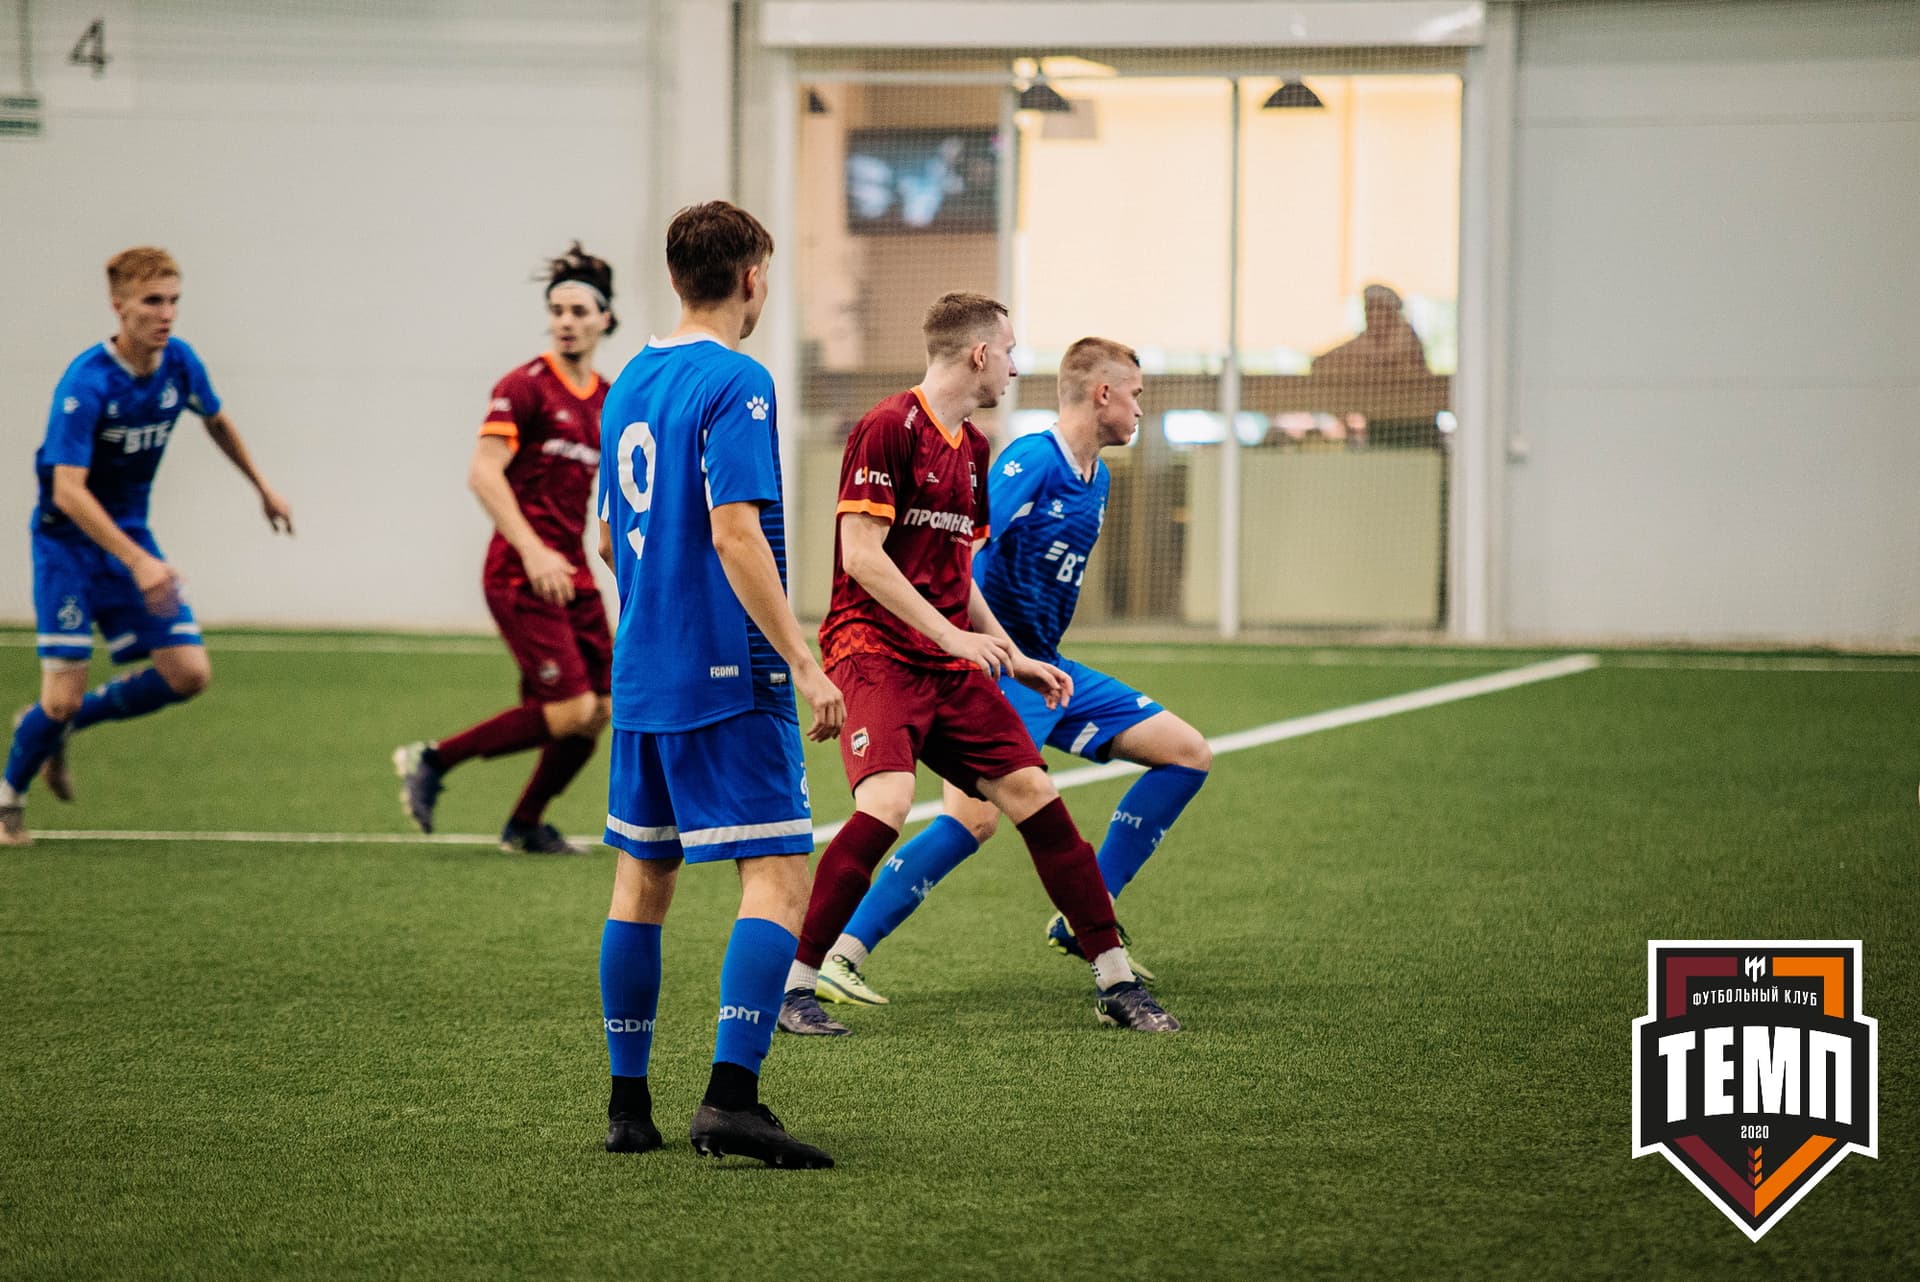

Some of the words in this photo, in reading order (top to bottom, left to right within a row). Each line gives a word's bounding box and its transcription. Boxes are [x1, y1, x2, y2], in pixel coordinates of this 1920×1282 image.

[68, 19, 112, 78] 4
[617, 421, 656, 560] 9
[868, 470, 893, 487] ПС
[1056, 552, 1086, 587] ВТ
[1111, 810, 1143, 829] DM
[719, 1005, 760, 1024] DM
